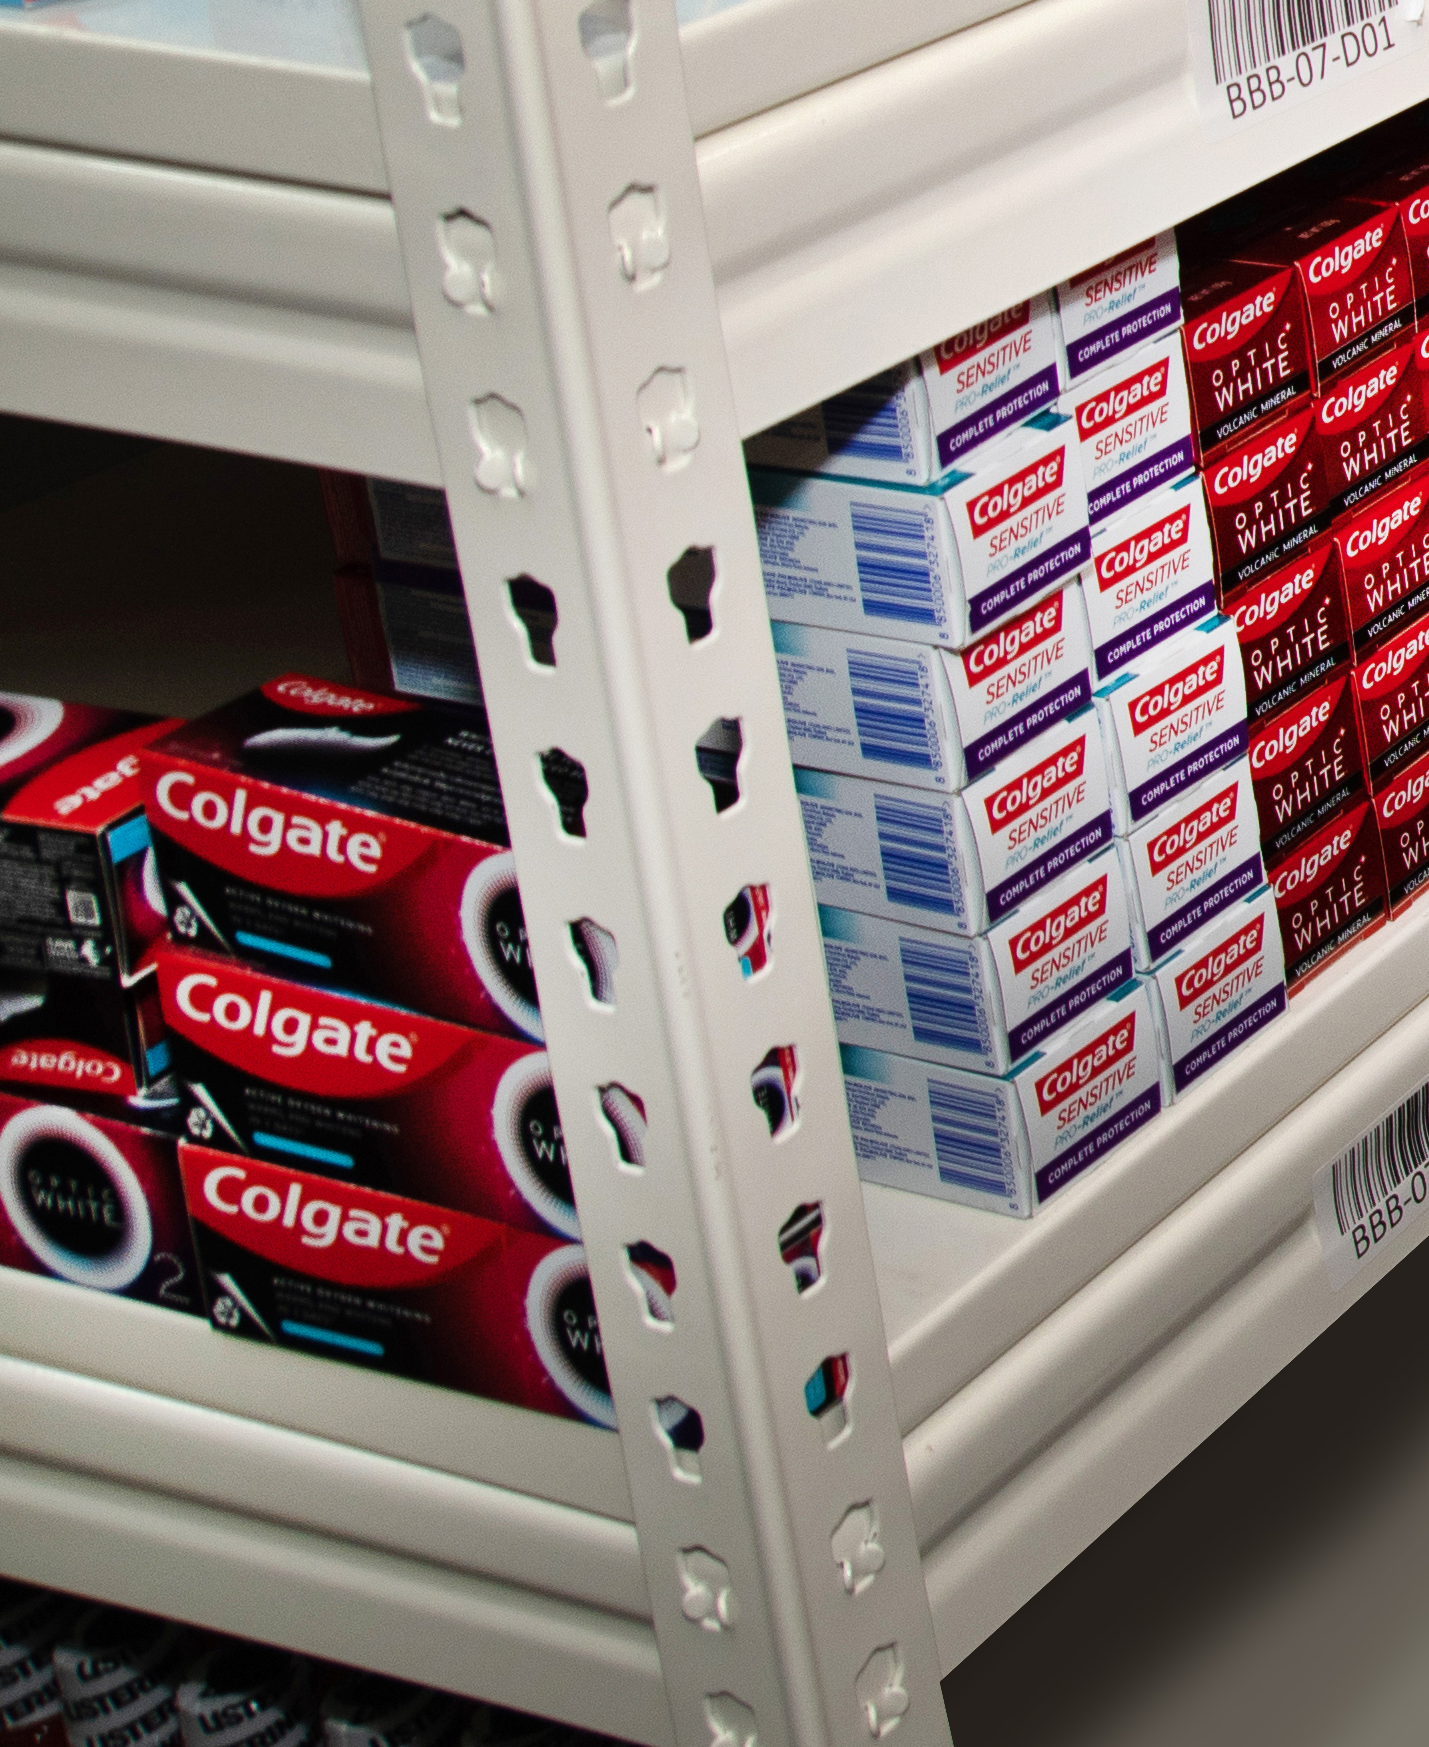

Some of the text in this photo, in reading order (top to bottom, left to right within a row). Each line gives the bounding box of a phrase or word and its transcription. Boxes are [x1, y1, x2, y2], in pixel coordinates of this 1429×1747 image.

[1226, 15, 1395, 120] BBB-07-D01
[1192, 287, 1276, 352] Colgate
[1212, 333, 1289, 386] OPTIC
[1213, 349, 1293, 411] WHITE
[1217, 385, 1297, 440] VOLCANIC MINERAL
[988, 493, 1066, 558] SENSITIVE
[980, 543, 1082, 615] COMPLETE PROTECTION
[155, 769, 385, 875] Colgate
[1294, 879, 1367, 952] WHITE
[174, 973, 416, 1074] Colgate
[1057, 1057, 1138, 1130] SENSITIVE
[1047, 1098, 1152, 1186] COMPLETE PROTECTION
[202, 1165, 446, 1265] Colgate
